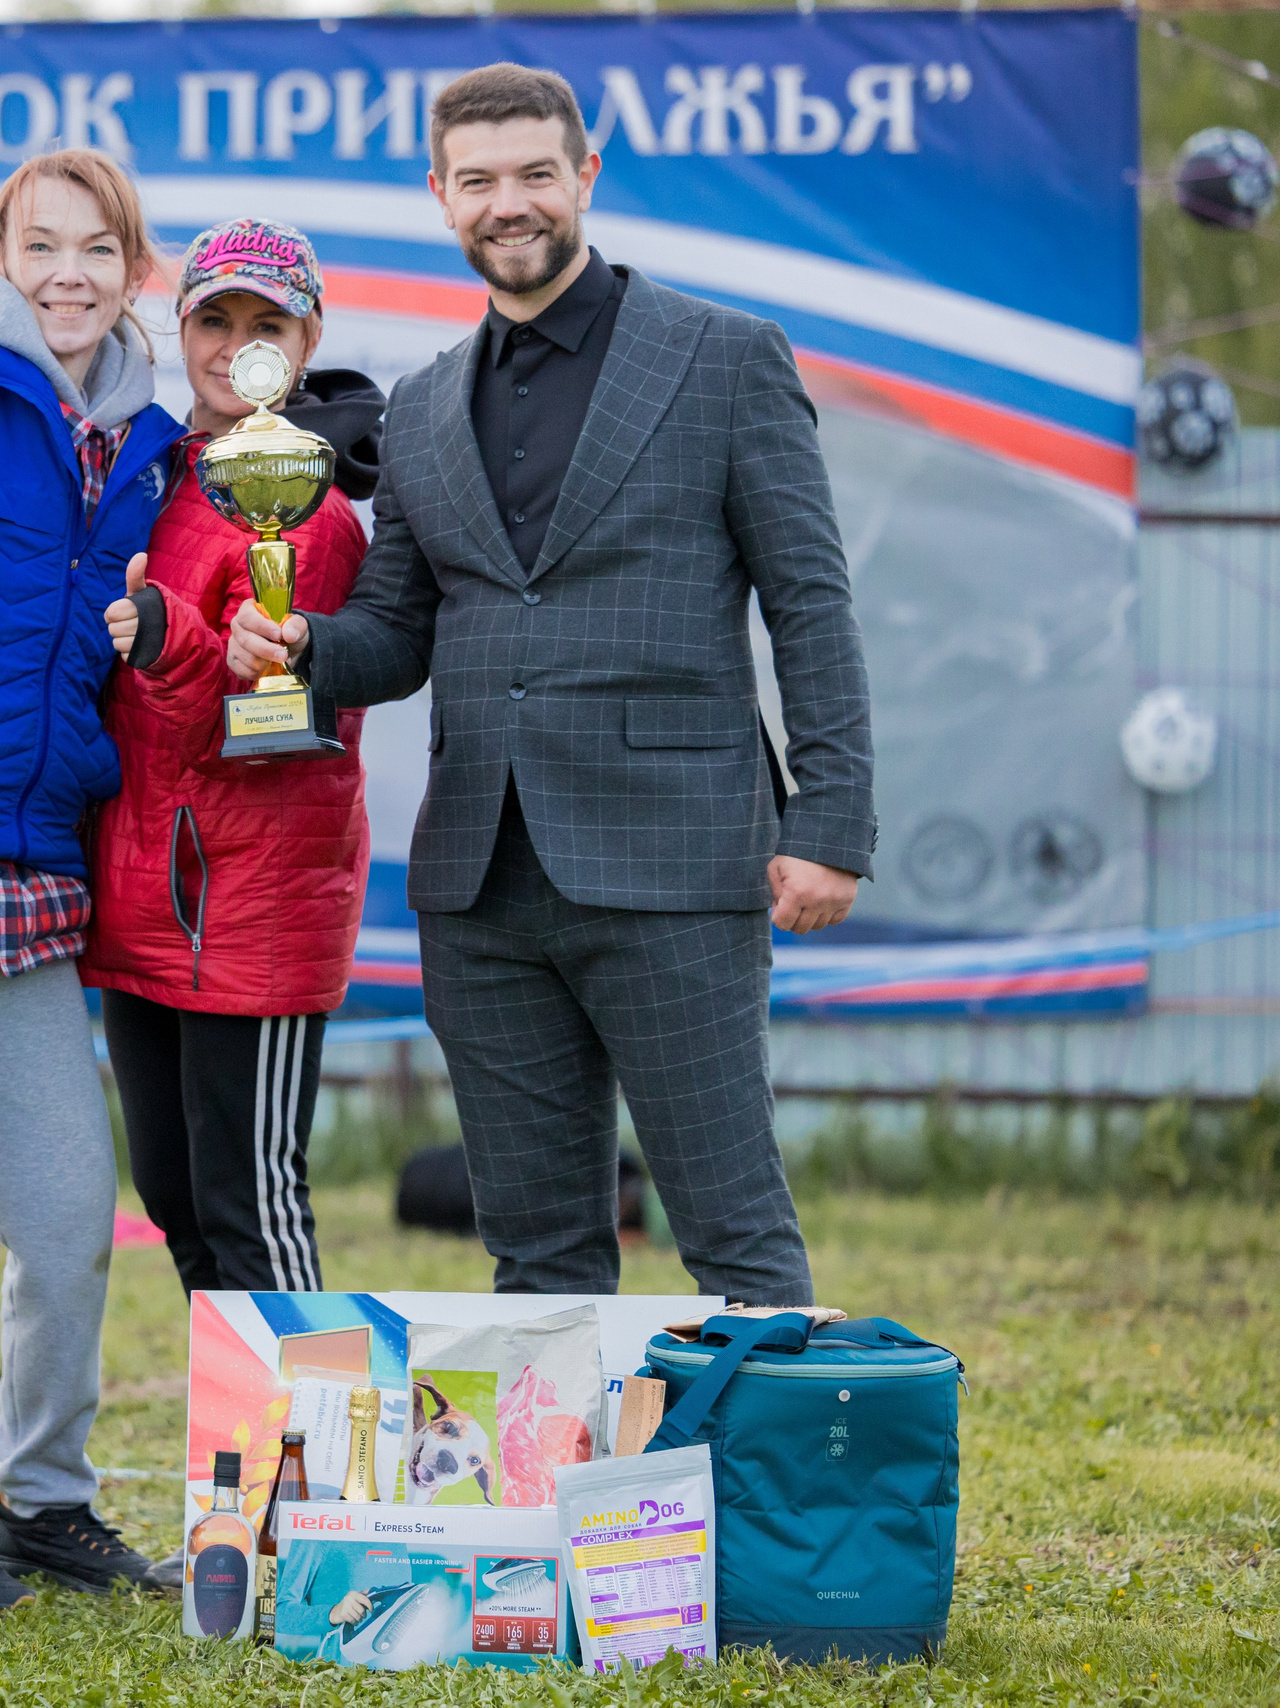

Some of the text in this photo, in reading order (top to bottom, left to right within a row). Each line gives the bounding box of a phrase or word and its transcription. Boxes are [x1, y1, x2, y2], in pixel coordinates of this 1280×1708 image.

[178, 62, 973, 161] ПРИЛЖЬЯ”
[196, 225, 297, 264] Madrid
[245, 713, 294, 725] ЛУЧШАЯ СУКА
[314, 1388, 327, 1439] petfabric.ru
[329, 1404, 340, 1439] возьмем
[829, 1426, 850, 1438] 20L
[359, 1430, 368, 1462] STEFANO
[288, 1513, 356, 1531] Tefal
[580, 1531, 634, 1545] COMPLEX
[816, 1591, 860, 1600] QUECHUA
[476, 1624, 494, 1635] 2400
[506, 1626, 522, 1639] 165
[538, 1627, 549, 1640] 35
